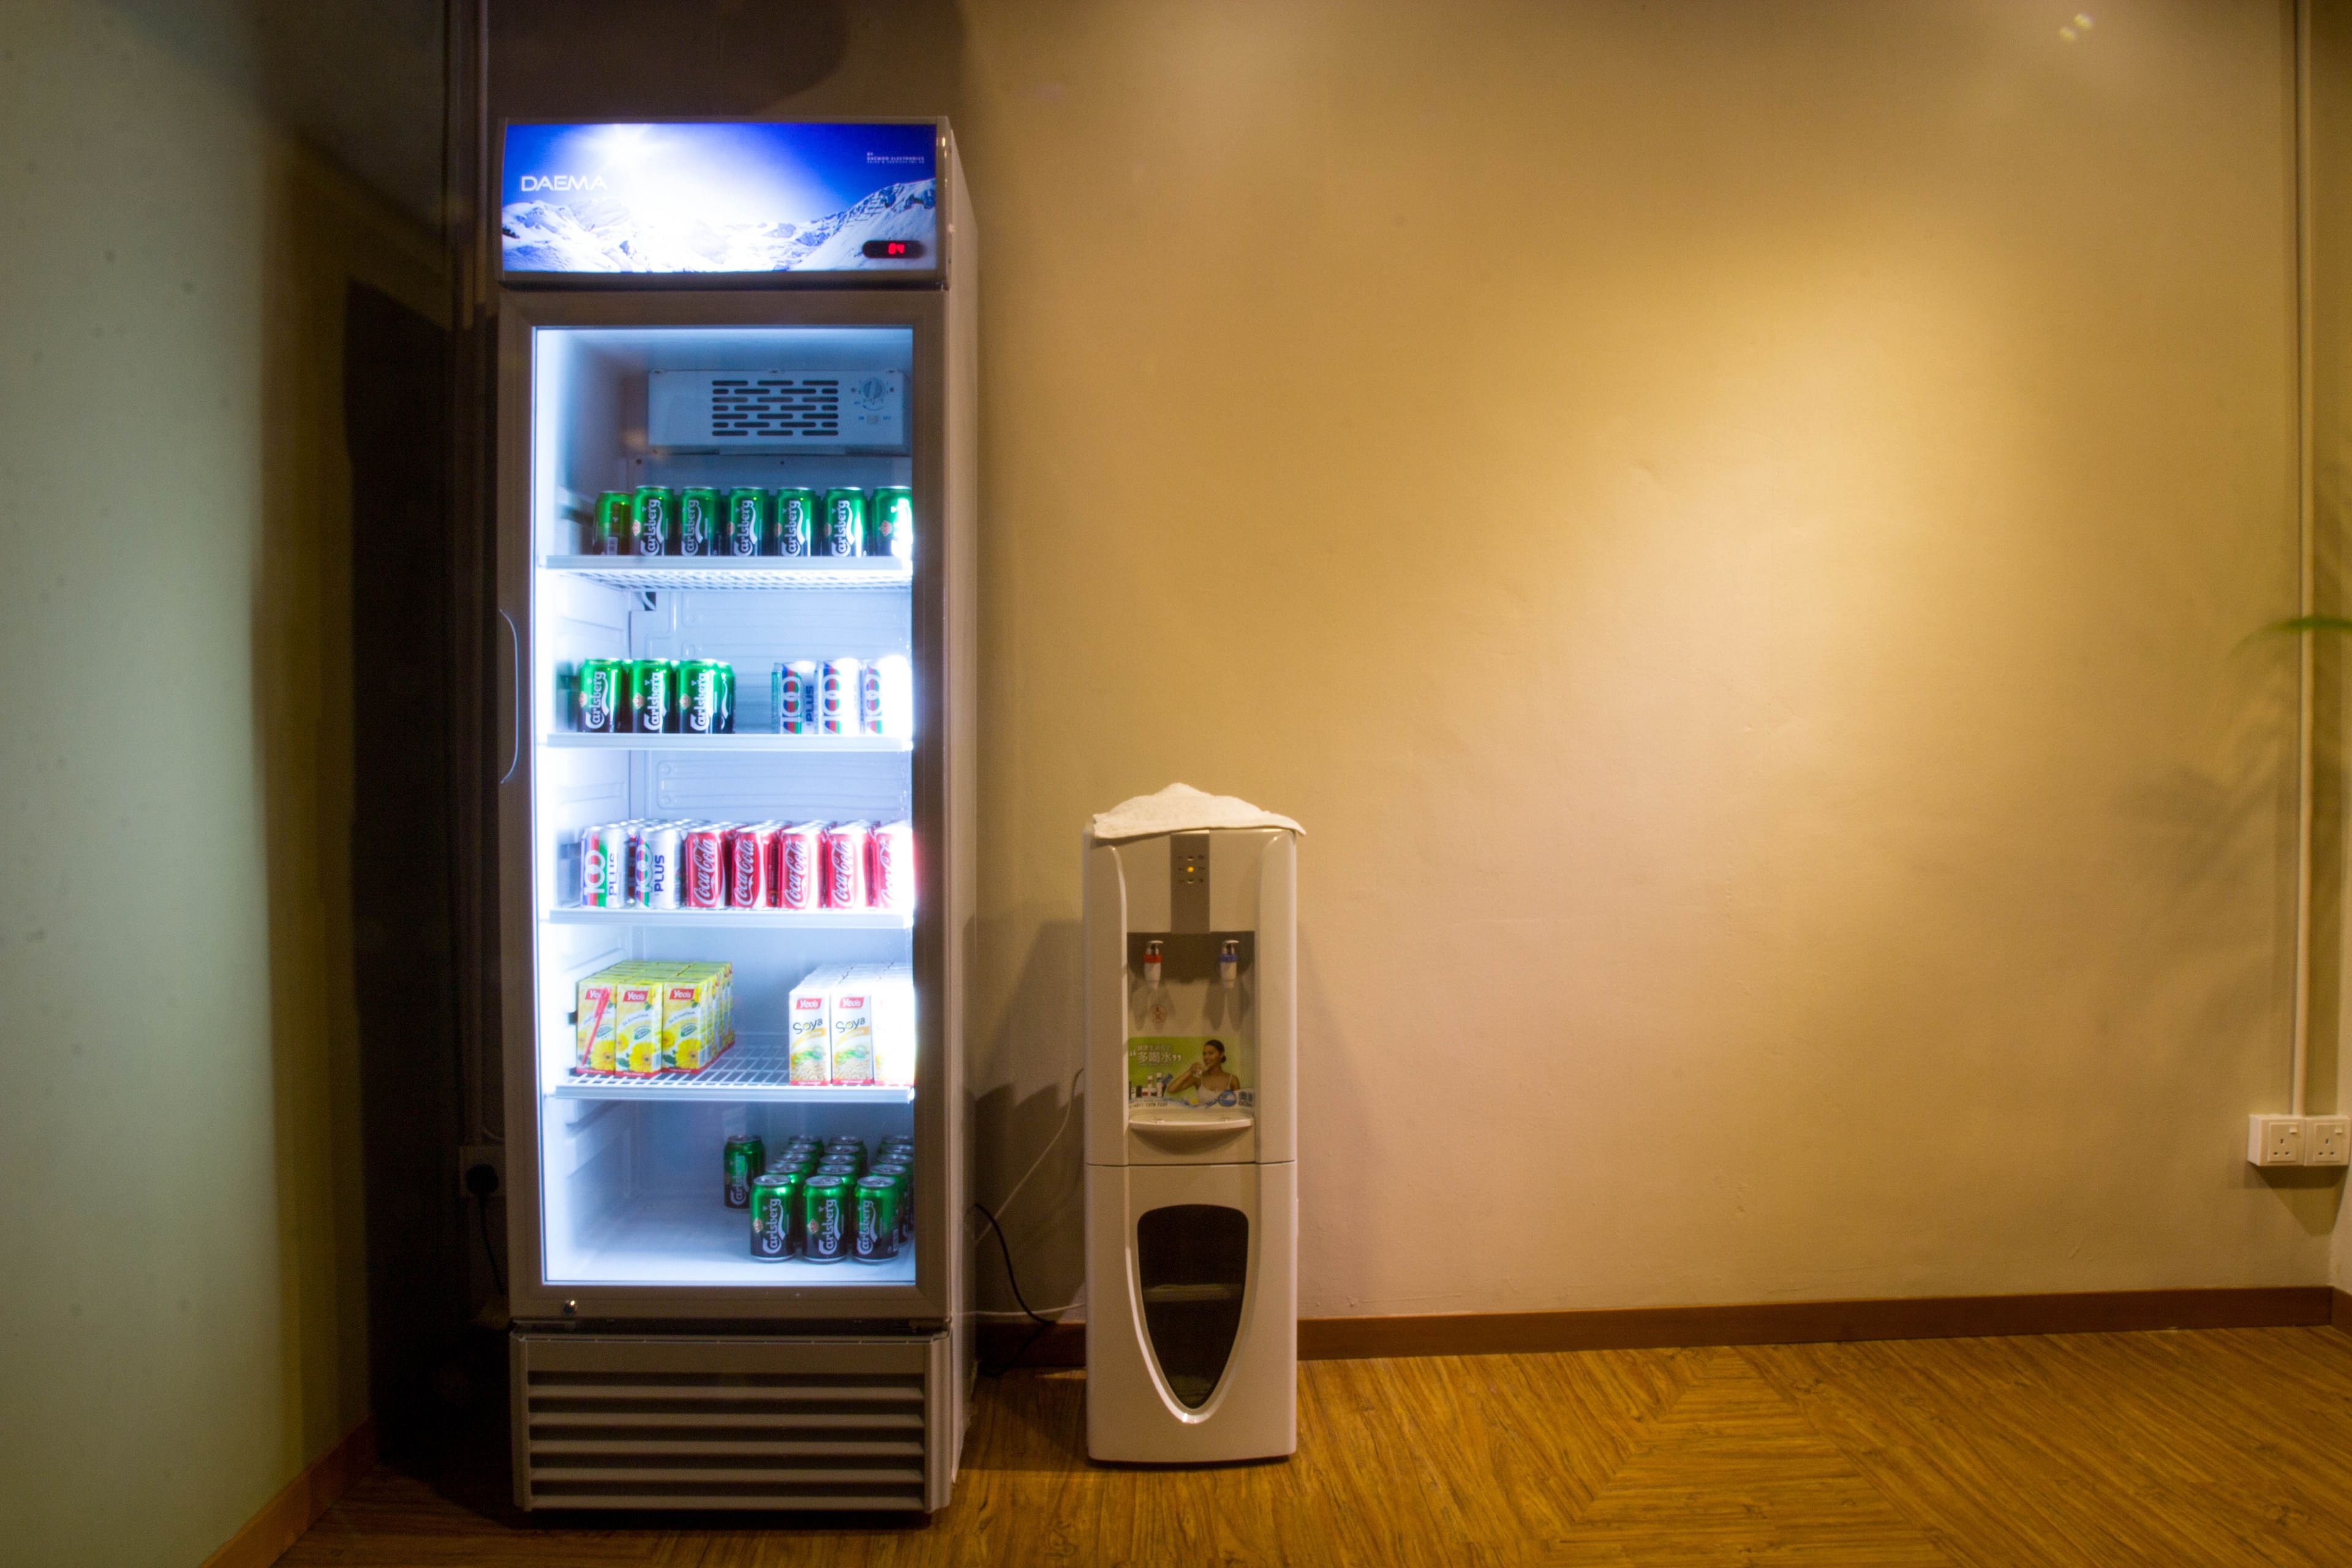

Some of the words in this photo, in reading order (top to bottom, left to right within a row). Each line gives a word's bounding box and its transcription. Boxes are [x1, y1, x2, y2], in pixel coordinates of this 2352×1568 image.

[521, 175, 608, 191] DAEMA
[641, 499, 664, 556] Carlsberg
[681, 499, 703, 556] Carlsberg
[734, 499, 758, 556] Carlsberg
[782, 499, 805, 556] Carlsberg
[831, 499, 855, 556] Carlsberg
[586, 671, 609, 729] Carlsberg
[781, 676, 804, 723] 100
[584, 850, 605, 895] 100
[654, 854, 665, 892] PLUS
[793, 1018, 823, 1035] Soya
[835, 1017, 865, 1033] Soya
[763, 1198, 786, 1254] Carlsberg
[818, 1199, 841, 1254] Carlsberg
[857, 1200, 878, 1255] Carlsberg
